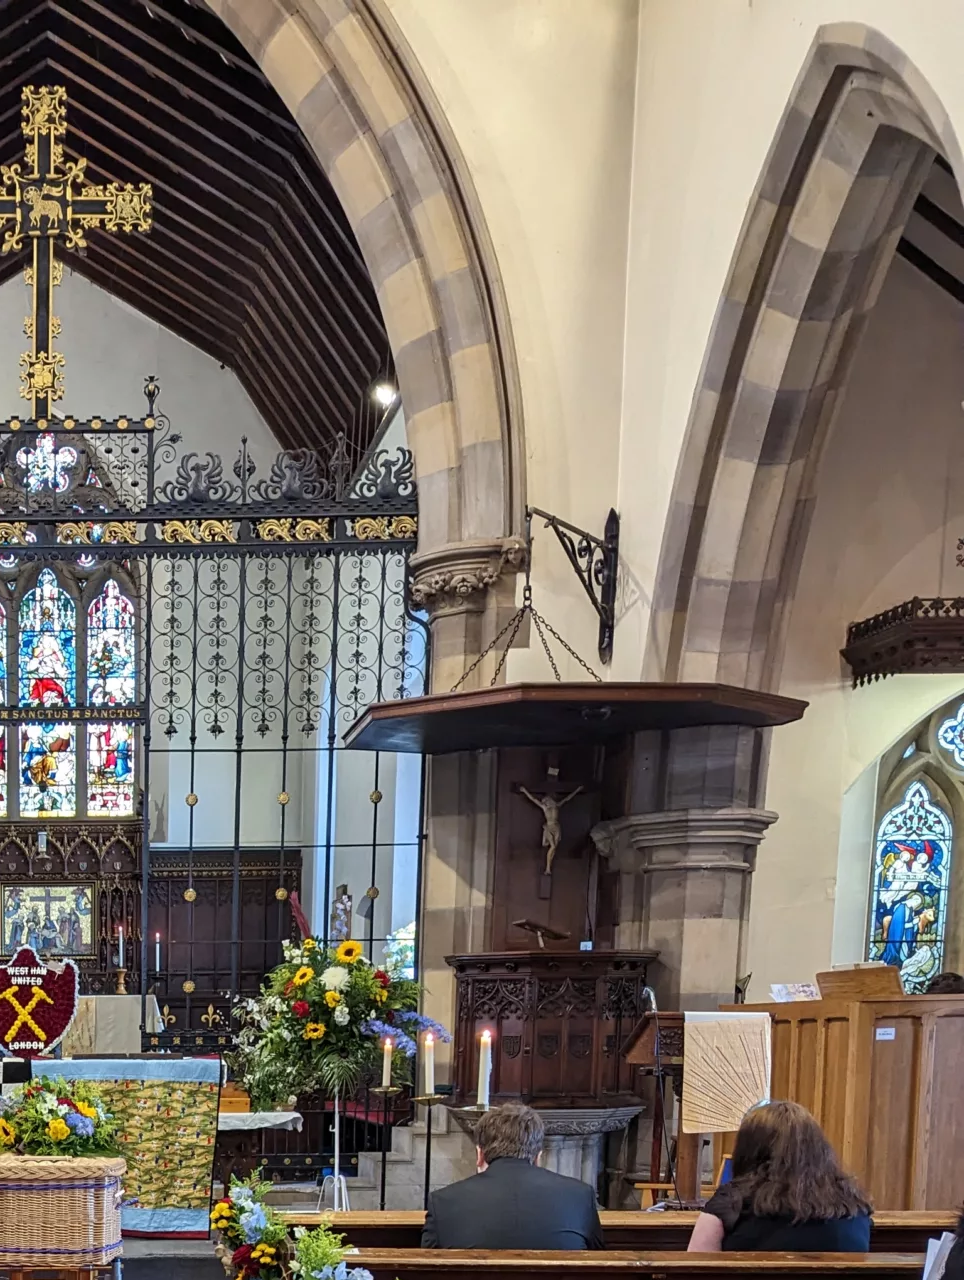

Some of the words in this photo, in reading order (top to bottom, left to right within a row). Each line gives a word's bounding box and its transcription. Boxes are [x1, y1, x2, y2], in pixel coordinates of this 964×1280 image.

[12, 710, 68, 719] SANCTUS
[84, 709, 140, 719] SANCTUS
[7, 966, 29, 976] WEST
[30, 966, 47, 976] HAM
[11, 976, 43, 986] UNITED
[9, 1041, 44, 1051] LONDON
